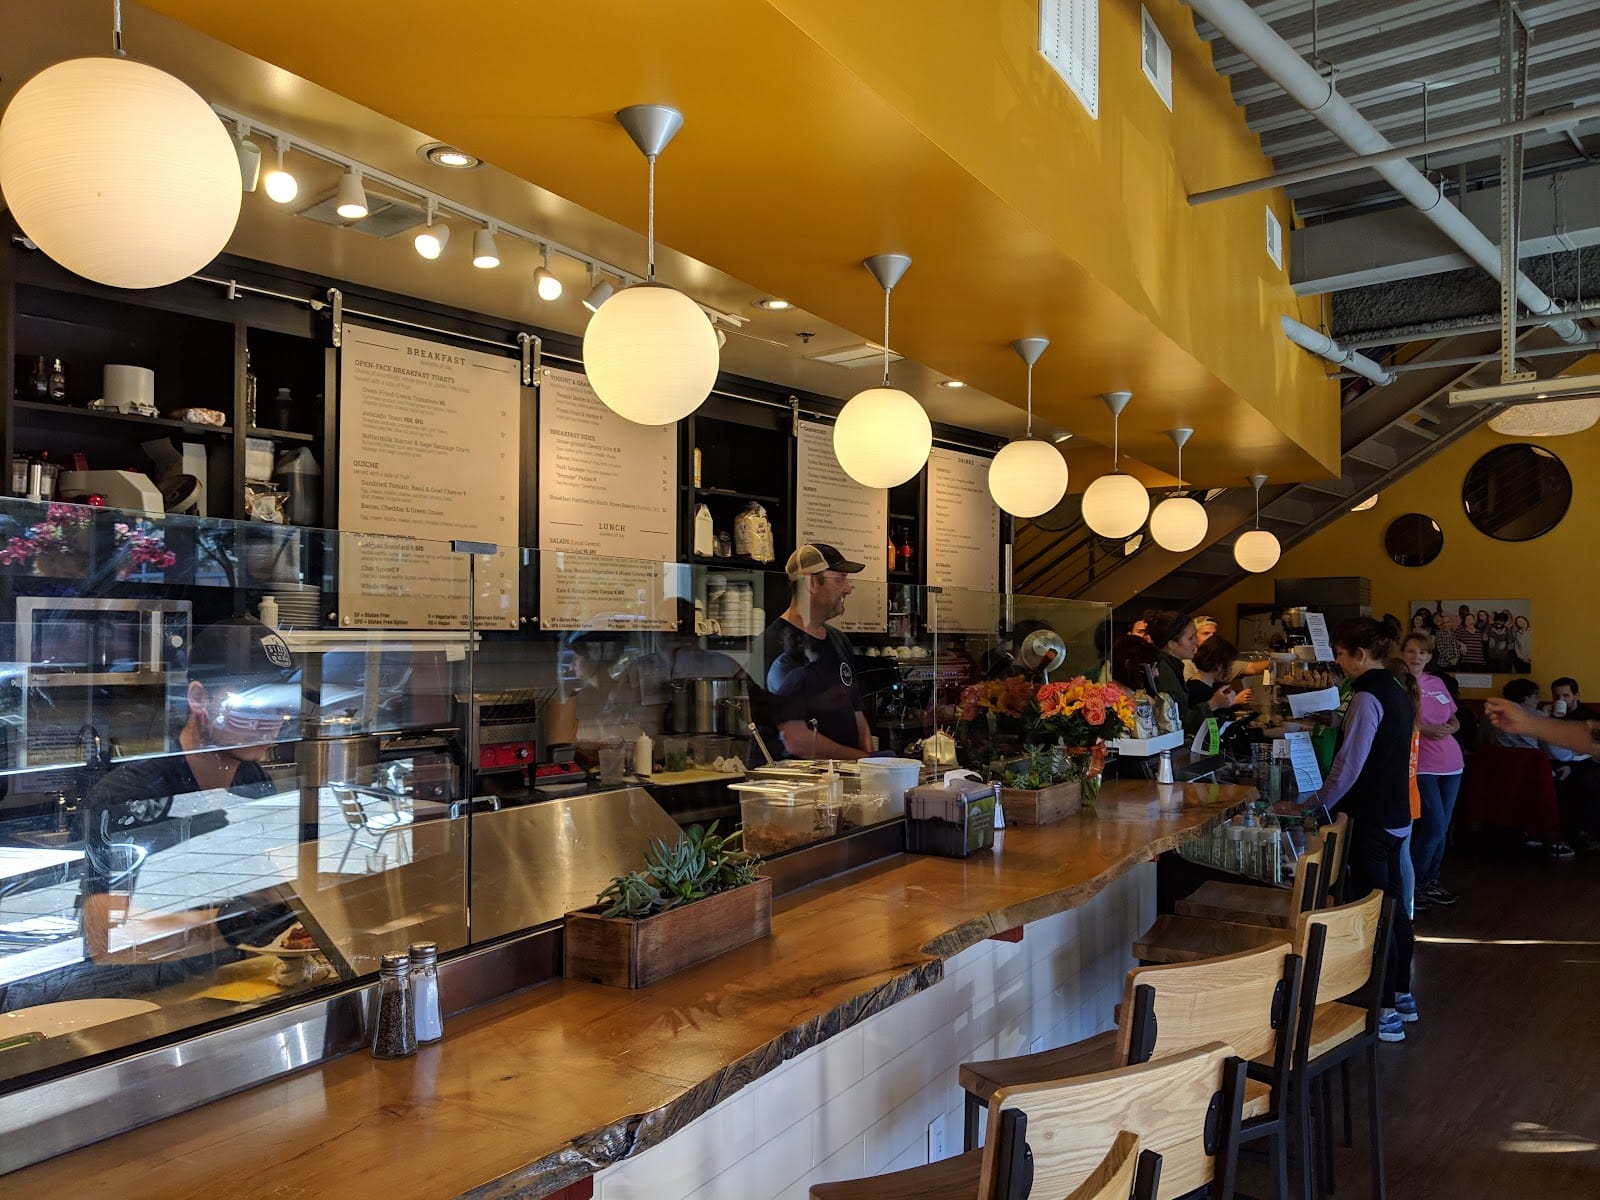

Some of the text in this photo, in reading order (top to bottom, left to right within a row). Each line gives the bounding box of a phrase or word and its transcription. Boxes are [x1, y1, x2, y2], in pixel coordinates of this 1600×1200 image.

[407, 347, 466, 366] BREAKFAST
[354, 360, 392, 372] OPEN-FACE
[393, 366, 430, 380] BREAKFAST
[432, 373, 456, 383] TOASTS
[550, 428, 580, 438] BREAKFAST
[353, 460, 379, 468] QUICHE
[599, 522, 626, 532] LUNCH
